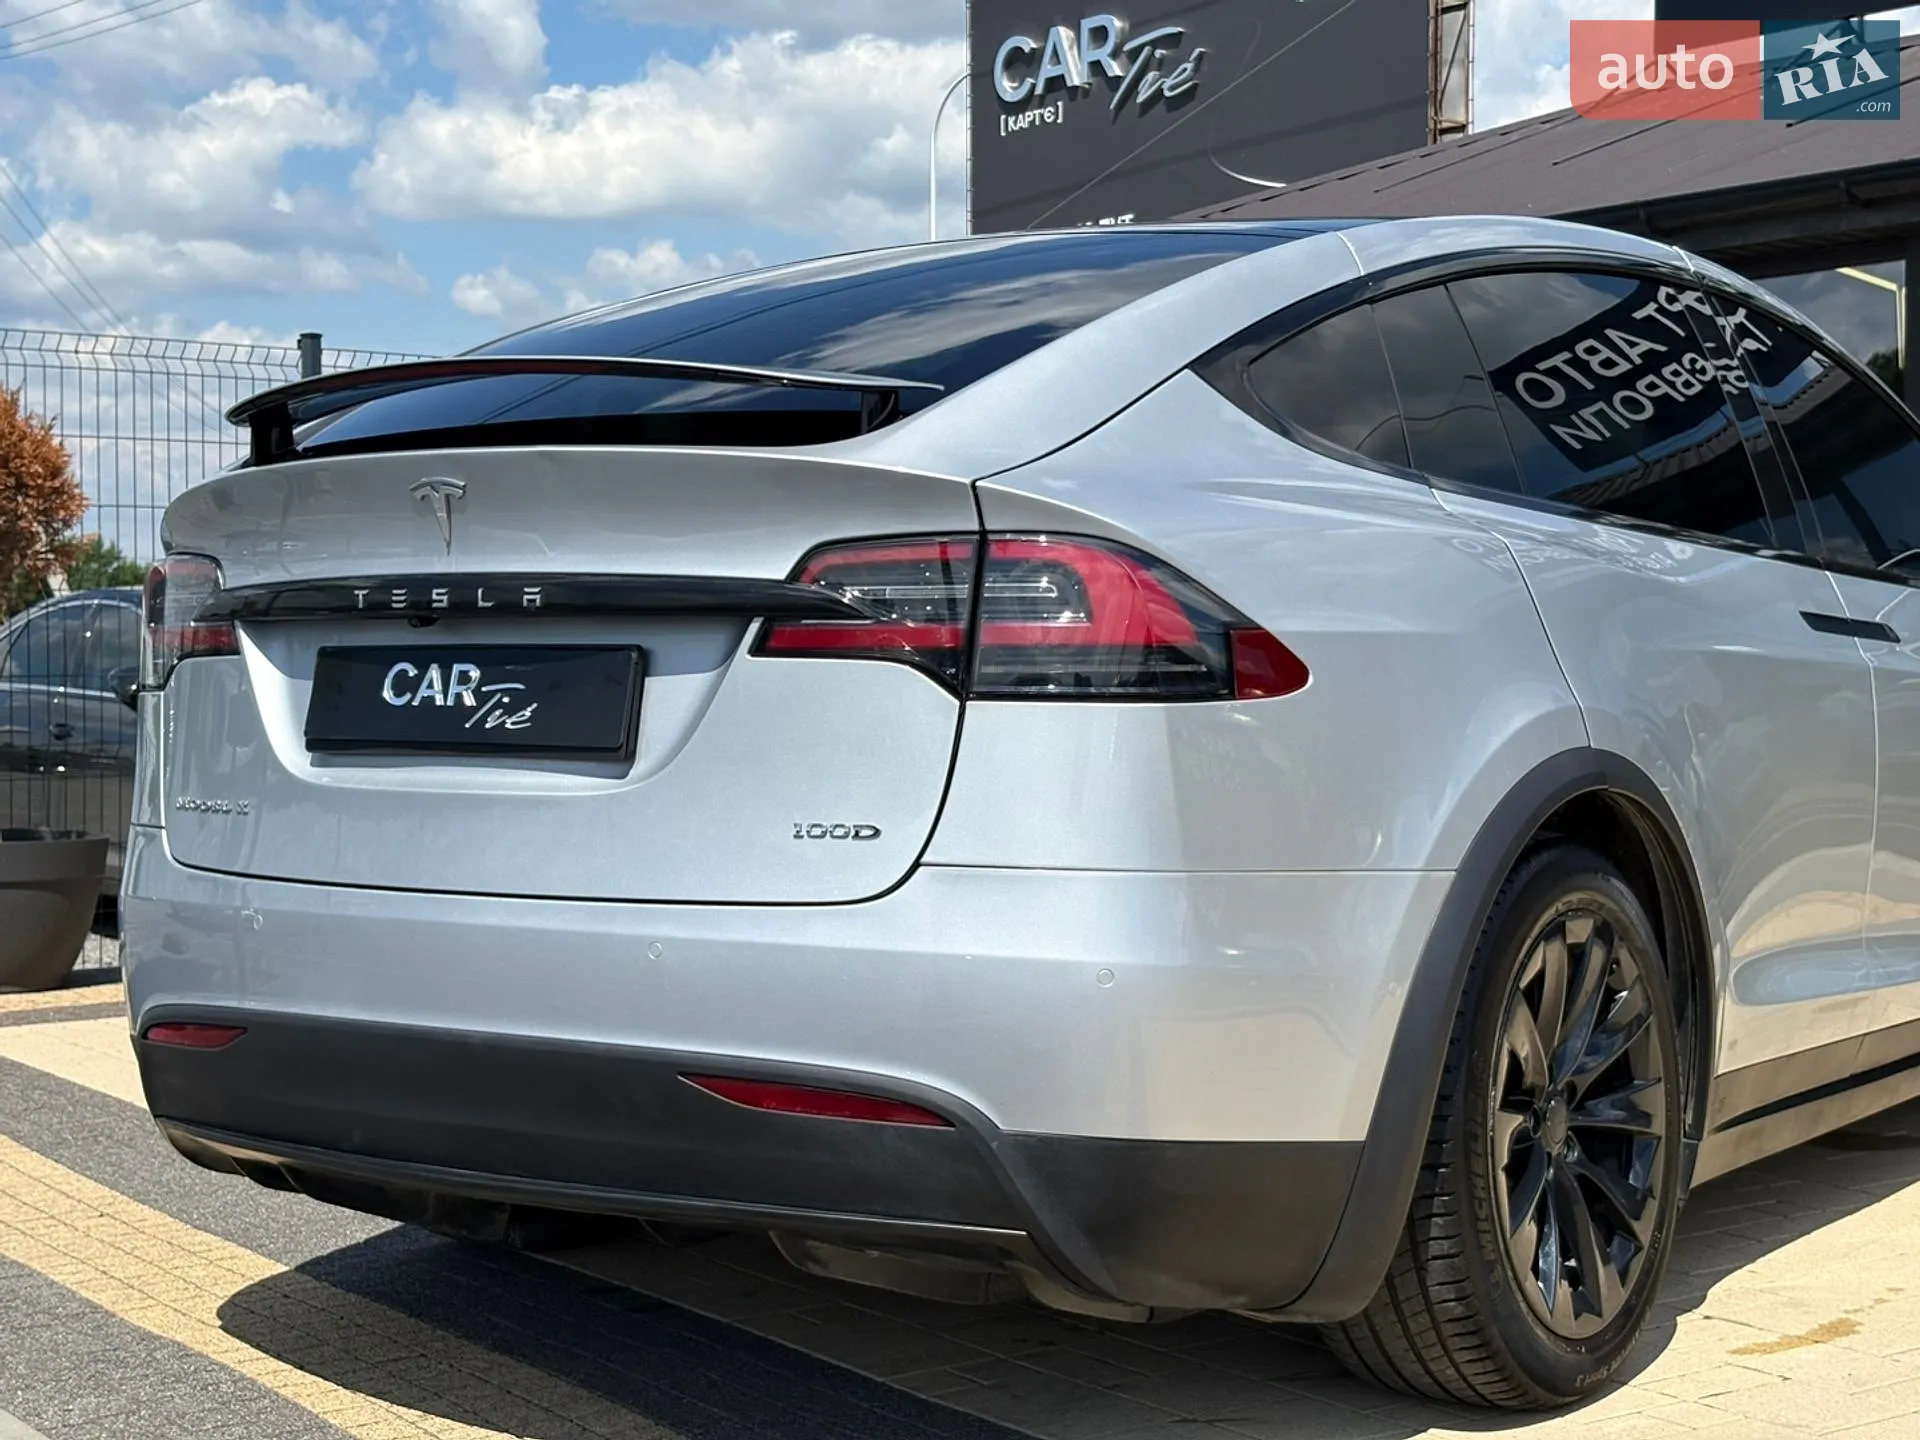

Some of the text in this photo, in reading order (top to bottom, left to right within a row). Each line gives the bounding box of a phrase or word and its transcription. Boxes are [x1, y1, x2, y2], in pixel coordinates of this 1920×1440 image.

[994, 14, 1125, 103] CAR
[353, 586, 542, 609] TESLA
[382, 661, 481, 707] CAR
[792, 822, 883, 841] 100D
